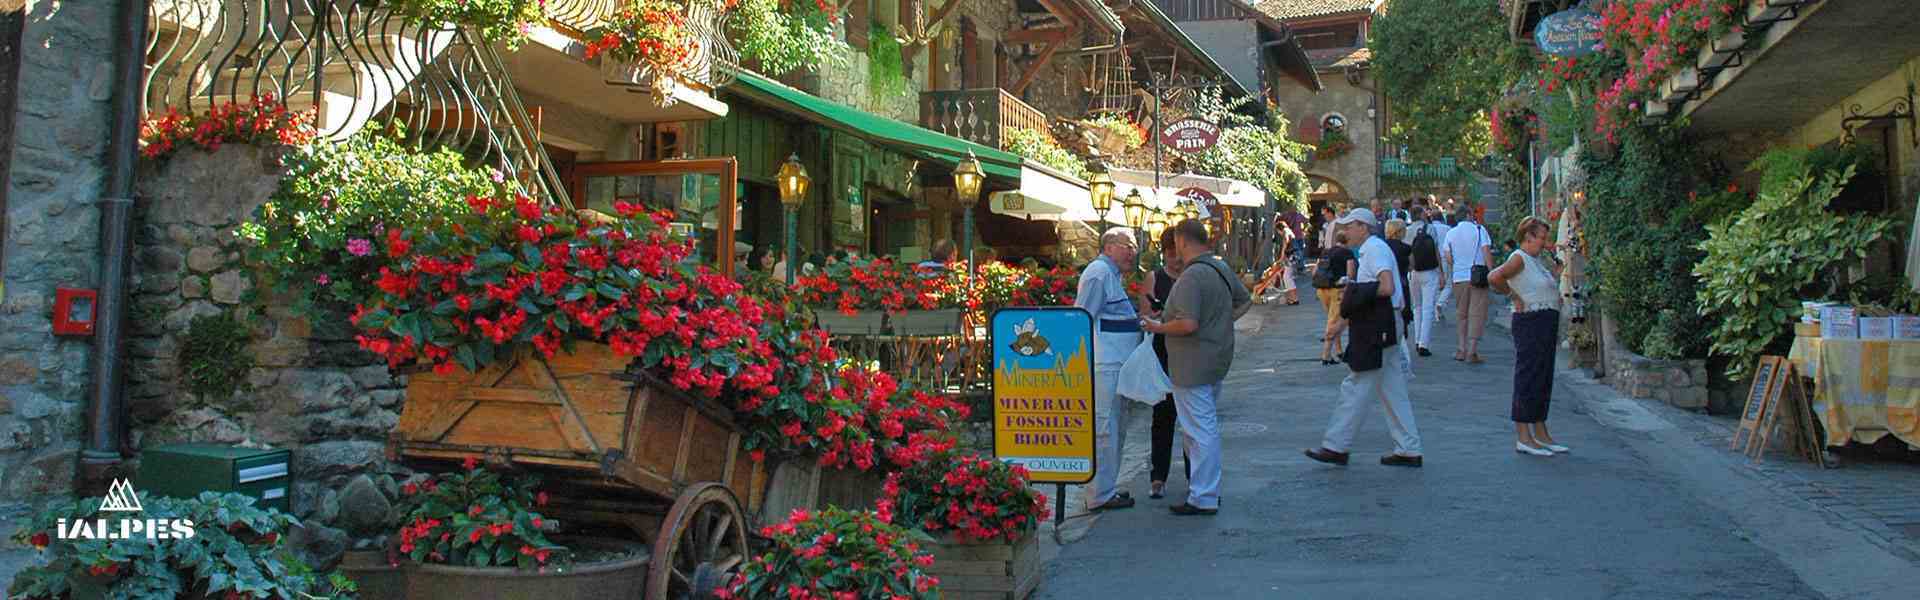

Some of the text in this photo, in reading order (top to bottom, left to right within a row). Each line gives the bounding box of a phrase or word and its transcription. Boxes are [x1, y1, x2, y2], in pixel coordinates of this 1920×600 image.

[1164, 119, 1217, 137] BRASSERIE
[1175, 138, 1206, 149] PAIN
[999, 398, 1088, 411] MINERAUX
[1006, 415, 1084, 428] FOSSILES
[1014, 433, 1073, 446] BIJOUX
[1028, 458, 1088, 471] OUVERT
